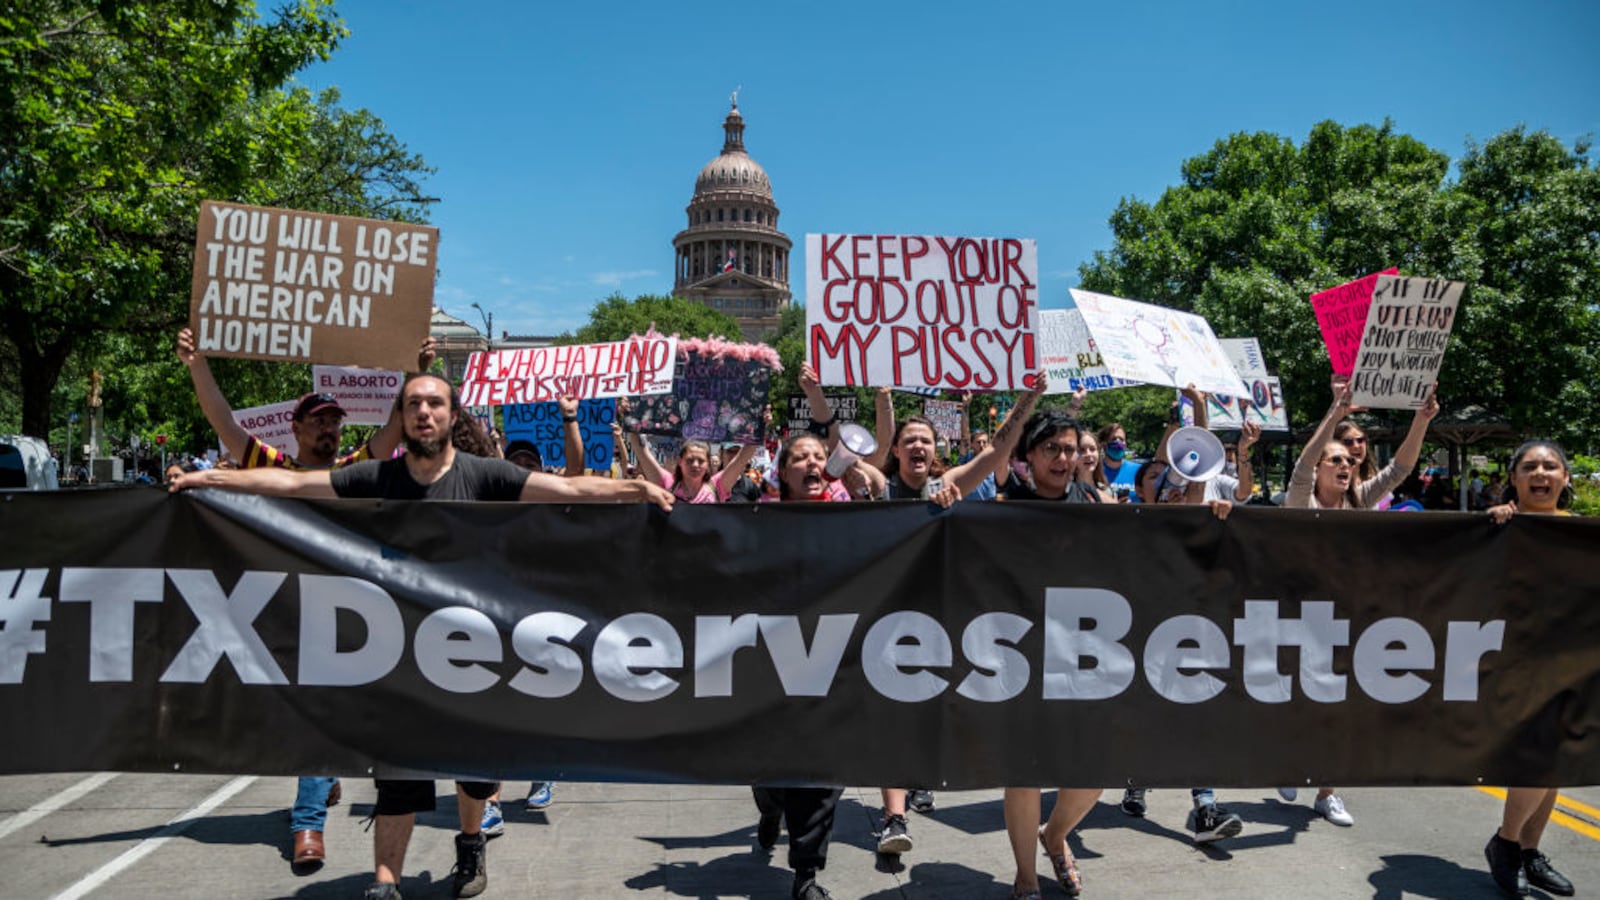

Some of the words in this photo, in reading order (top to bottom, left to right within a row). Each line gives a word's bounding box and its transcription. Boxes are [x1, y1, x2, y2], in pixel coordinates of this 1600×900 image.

[210, 205, 270, 244] YOU
[277, 214, 342, 254] WILL
[355, 225, 430, 266] LOSE
[206, 243, 266, 281] THE
[273, 251, 344, 289] WAR
[353, 261, 396, 296] ON
[821, 234, 929, 281] KEEP
[934, 236, 1029, 285] YOUR
[199, 280, 372, 328] AMERICAN
[823, 278, 909, 324] GOD
[916, 279, 984, 327] OUT
[998, 284, 1036, 329] OF
[1391, 278, 1412, 298] IF
[1423, 280, 1452, 300] MY
[198, 317, 313, 358] WOMEN
[1323, 306, 1352, 330] JUST
[1364, 325, 1407, 348] SHOT
[1378, 304, 1453, 330] UTERUS
[465, 350, 497, 381] HE
[498, 348, 548, 379] WHO
[553, 343, 626, 376] HATH
[625, 339, 670, 373] NO
[811, 323, 881, 386] MY
[891, 324, 1036, 389] PUSSY!
[1361, 351, 1387, 369] YOU
[320, 375, 336, 387] EL
[338, 375, 398, 388] ABORTO
[459, 375, 552, 407] UTERUS
[0, 567, 1506, 703] #TXDeservesBetter
